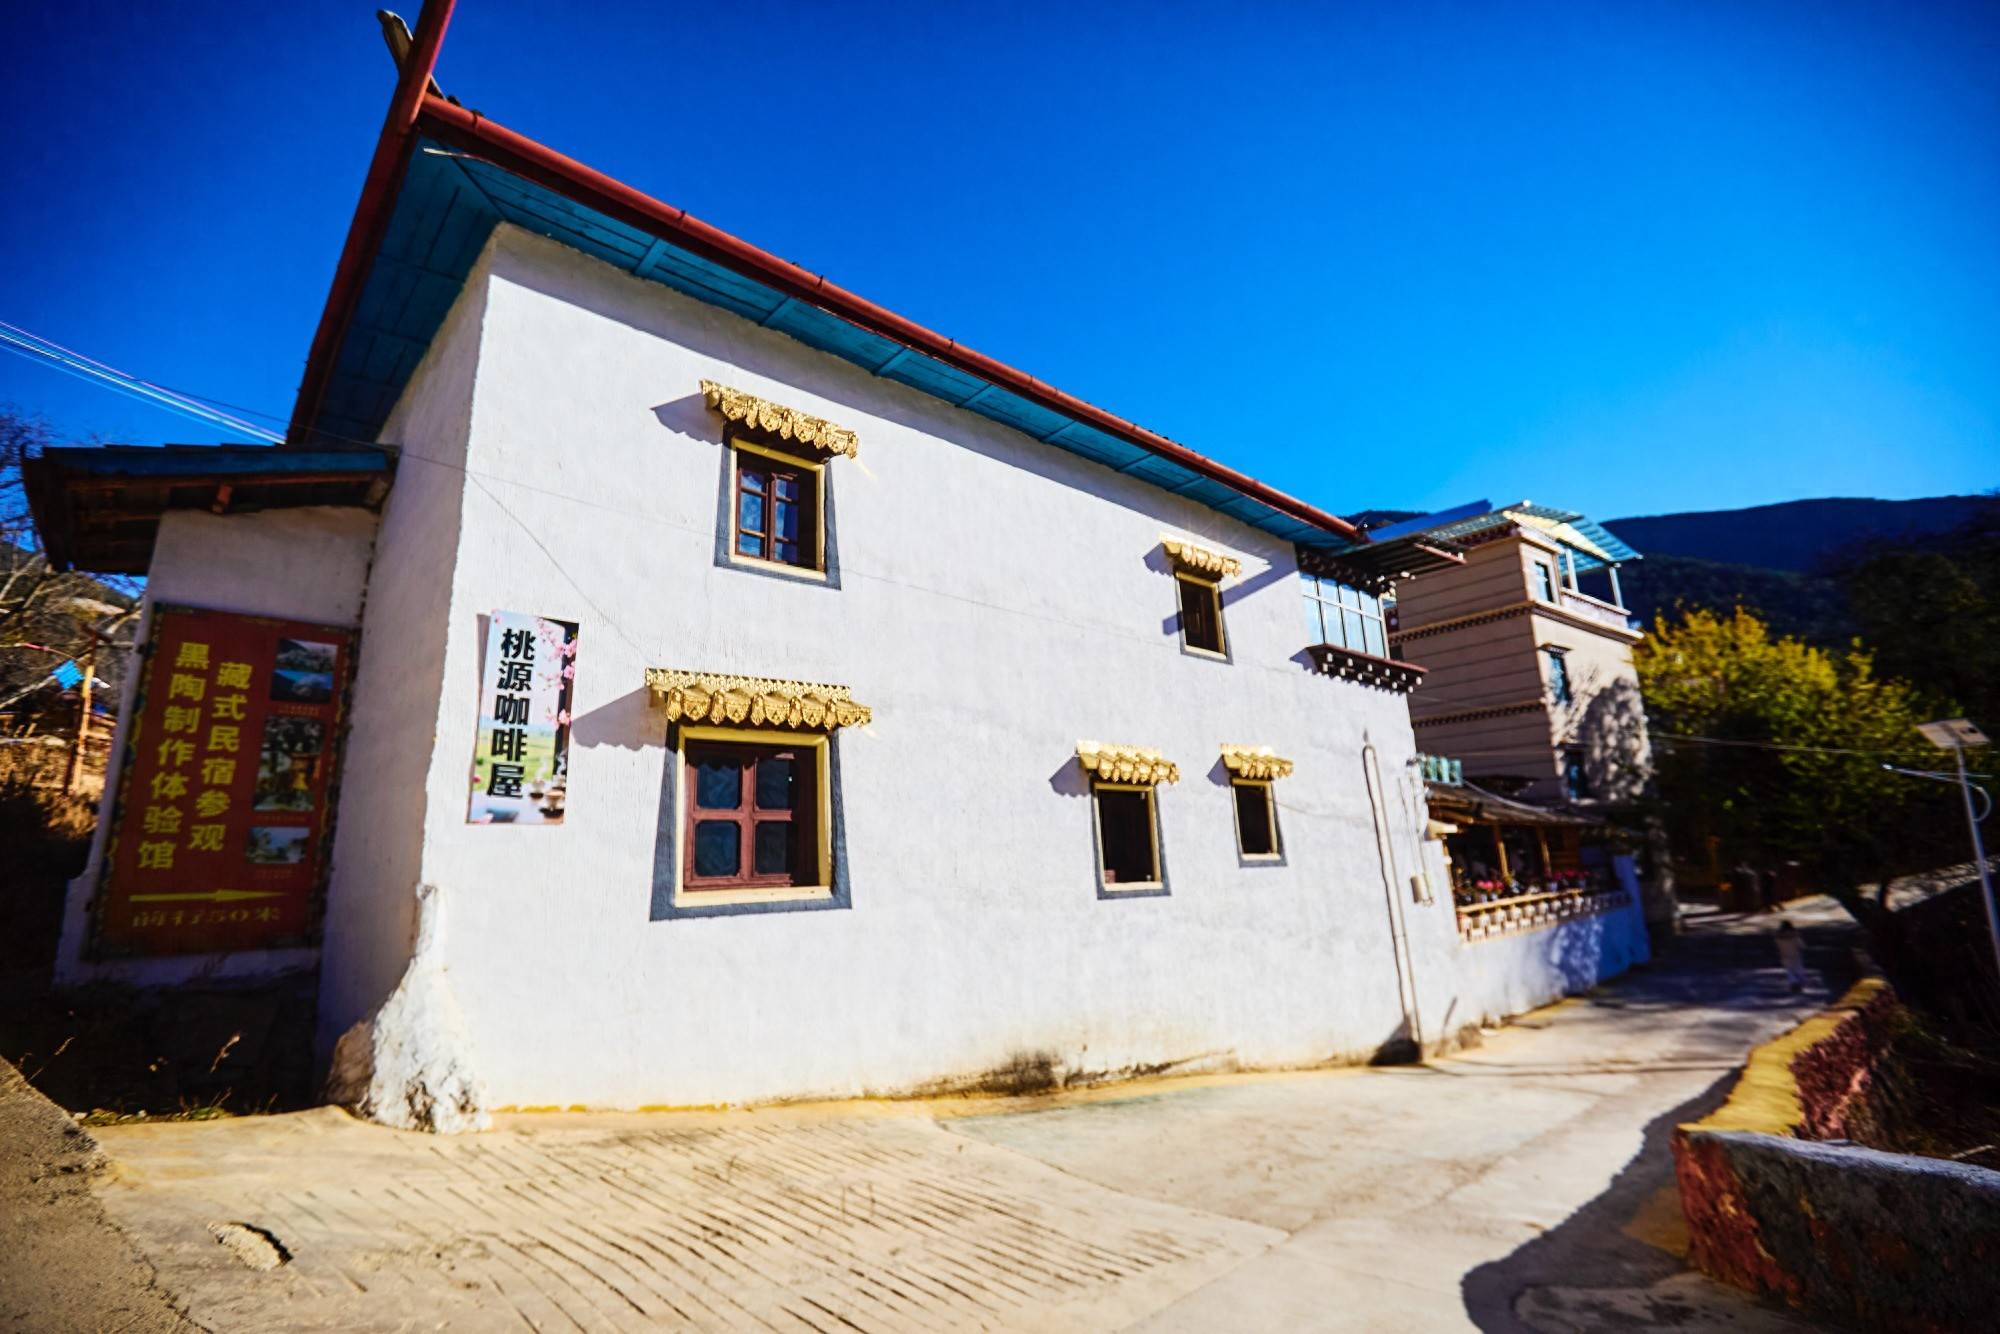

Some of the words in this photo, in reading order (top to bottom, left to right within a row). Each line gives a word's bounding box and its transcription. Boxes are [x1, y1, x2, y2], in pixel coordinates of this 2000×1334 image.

[137, 641, 211, 871] 黑陶制作体验馆
[187, 660, 253, 852] 藏式民宿参观
[486, 627, 537, 799] 桃源咖啡屋
